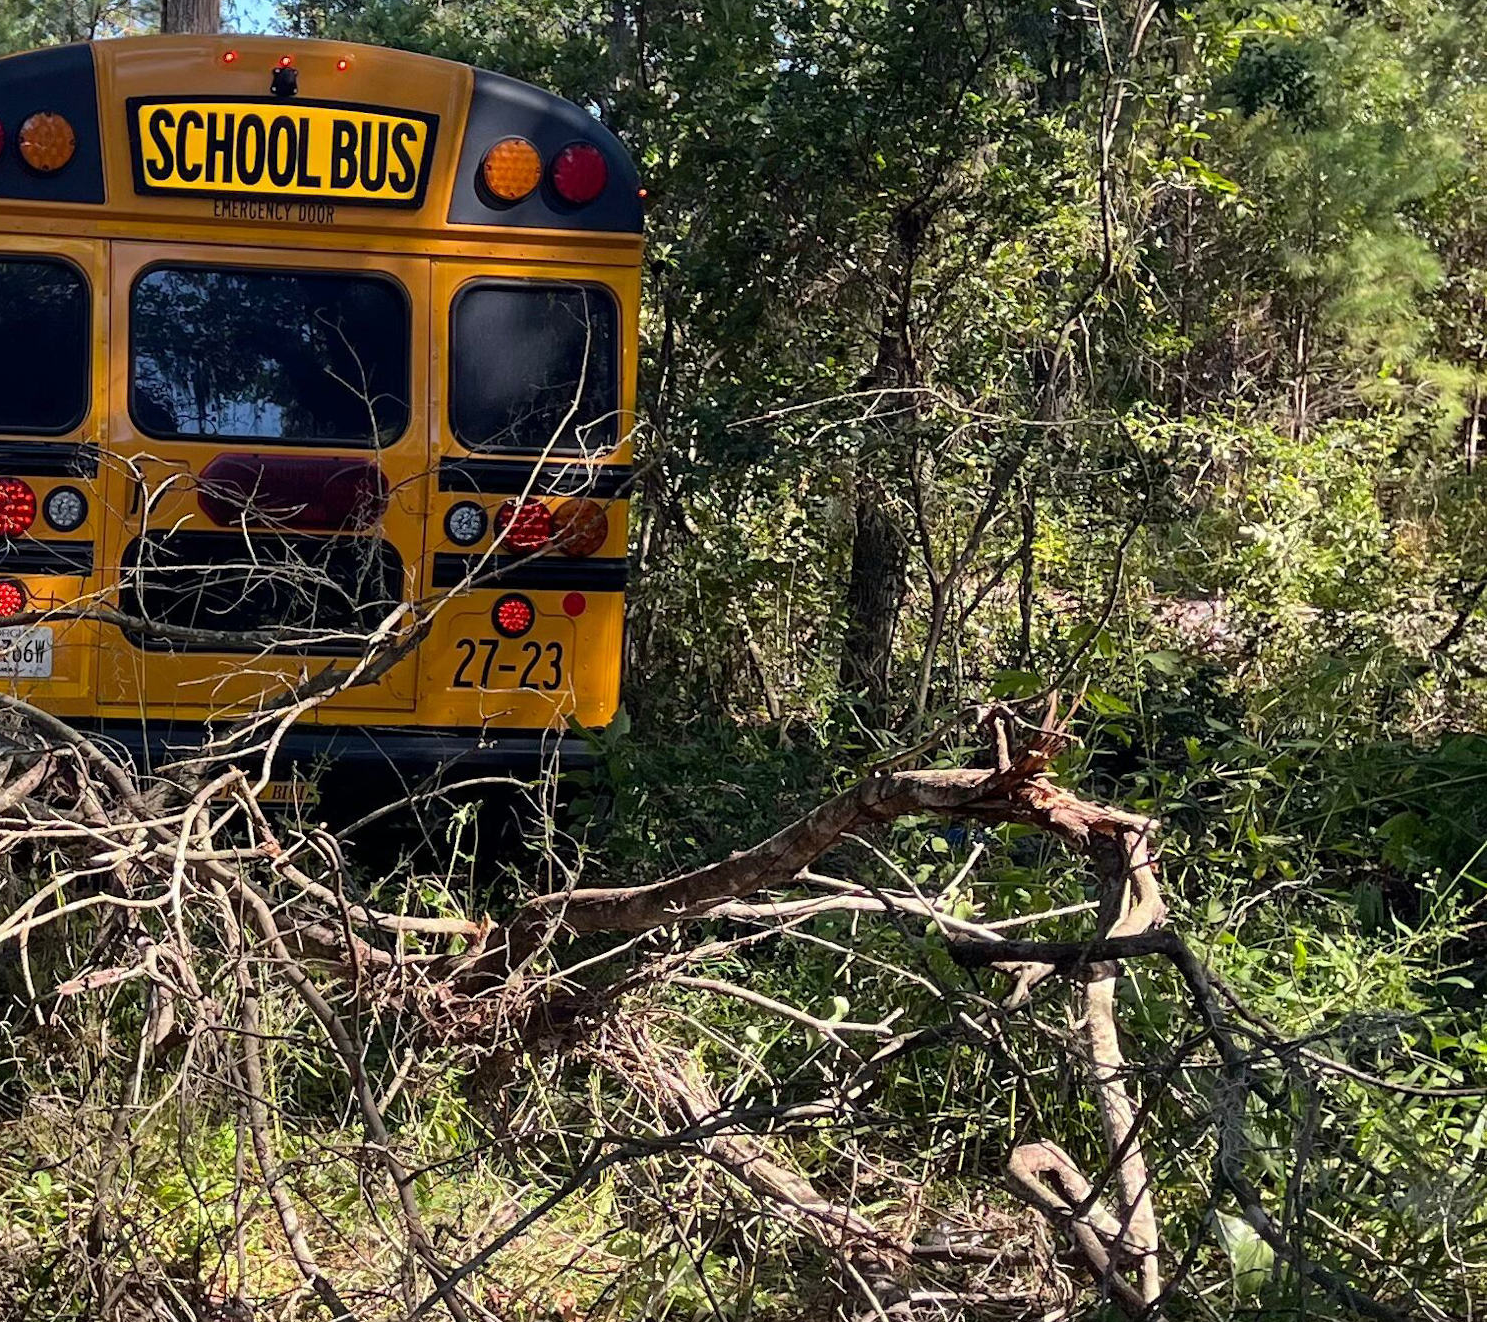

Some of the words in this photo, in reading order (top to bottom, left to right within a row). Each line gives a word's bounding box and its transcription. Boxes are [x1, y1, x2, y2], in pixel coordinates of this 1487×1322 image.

[146, 108, 321, 188] SCHOOL
[330, 119, 418, 194] BUS
[214, 198, 292, 221] EMERGENCY
[298, 203, 335, 224] DOOR
[453, 638, 563, 691] 27-23
